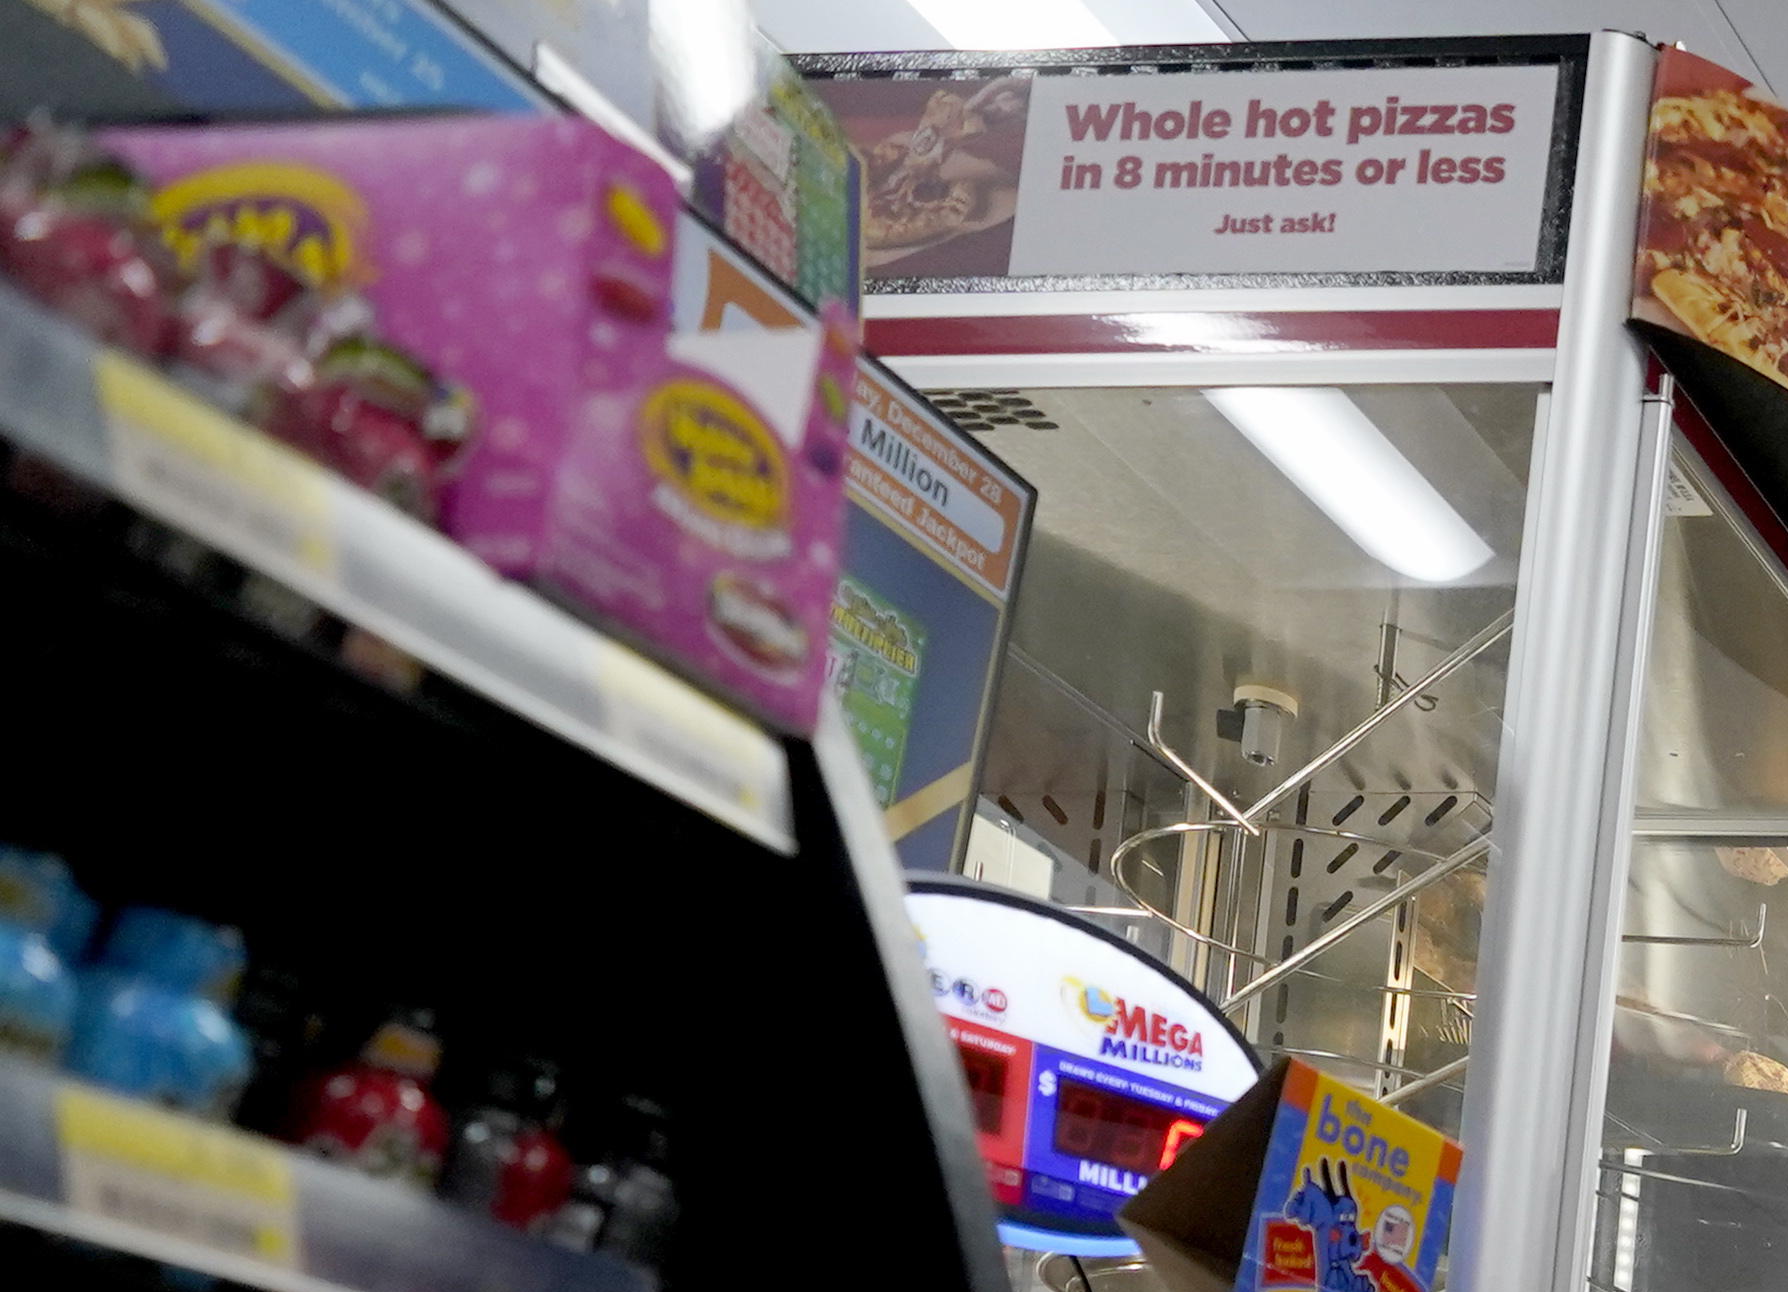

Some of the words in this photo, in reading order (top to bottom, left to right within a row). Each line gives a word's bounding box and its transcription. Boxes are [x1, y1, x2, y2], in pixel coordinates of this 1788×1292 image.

[1064, 101, 1230, 142] Whole
[1246, 99, 1334, 138] hot
[1348, 96, 1515, 145] pizzas
[1060, 156, 1107, 190] in
[1116, 155, 1143, 190] 8
[1154, 152, 1342, 189] minutes
[1355, 156, 1406, 186] or
[1417, 151, 1505, 185] less
[1214, 214, 1274, 235] Just
[1281, 212, 1335, 234] ask!
[861, 419, 949, 508] Million
[886, 399, 978, 486] December
[914, 498, 986, 573] Jackpot
[1108, 997, 1203, 1057] MEGA
[1100, 1036, 1202, 1073] MILLIONS
[1039, 1071, 1056, 1097] $
[1316, 1093, 1410, 1178] bone
[1351, 1161, 1423, 1208] company
